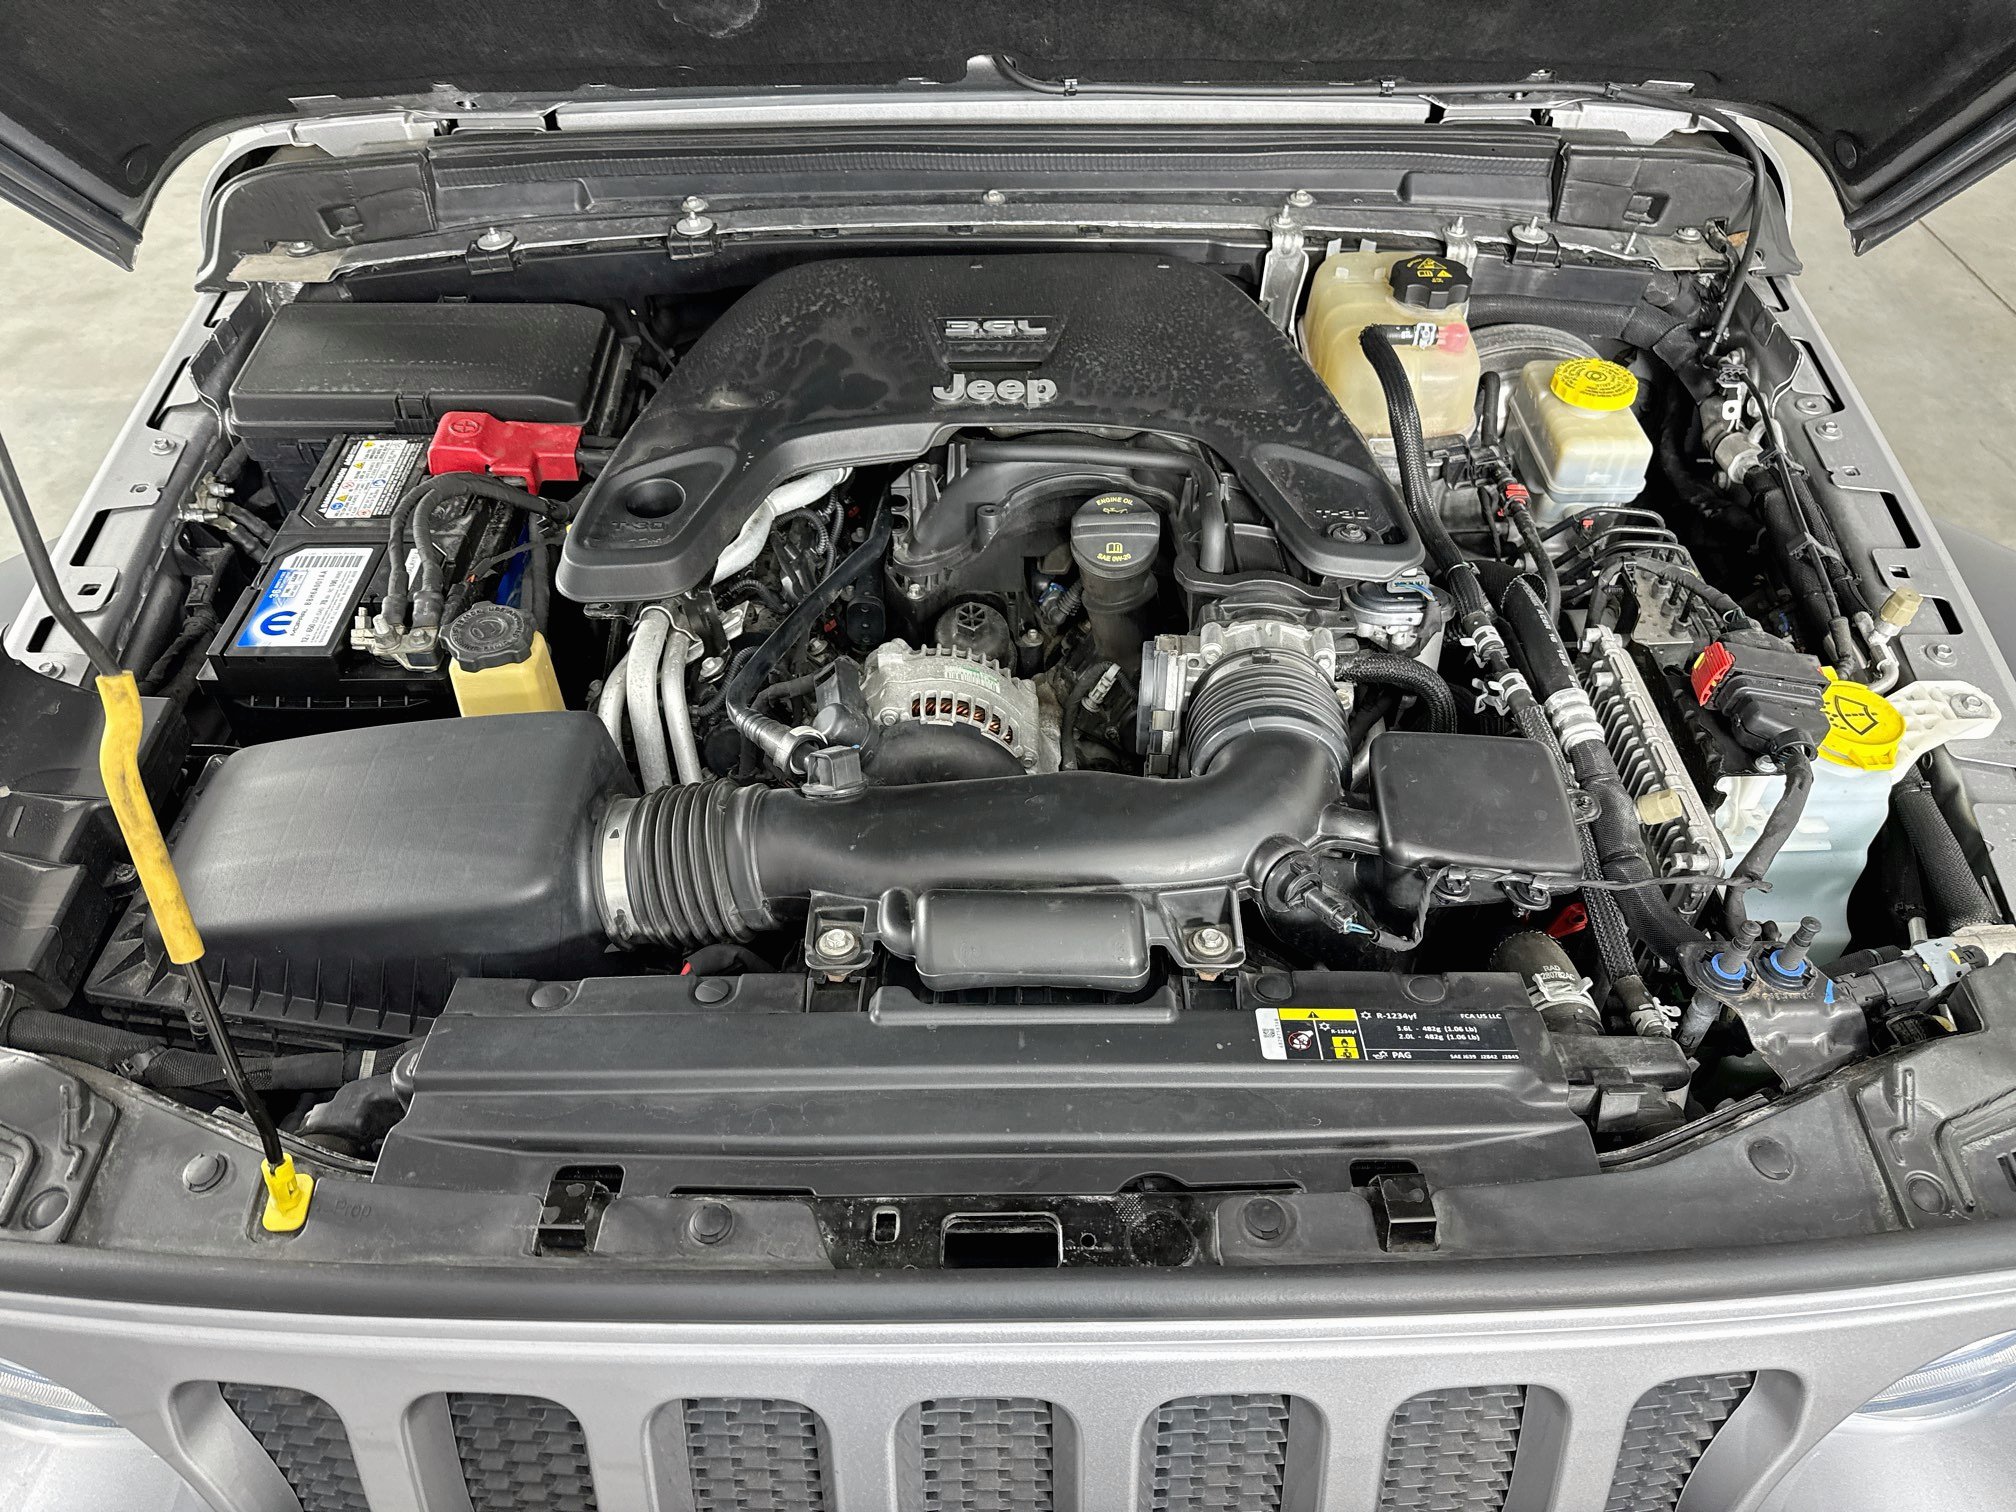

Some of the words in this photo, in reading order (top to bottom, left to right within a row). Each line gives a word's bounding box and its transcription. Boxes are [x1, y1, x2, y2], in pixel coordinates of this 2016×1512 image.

[944, 320, 1047, 336] 3.6L
[932, 373, 1058, 407] Jeep
[1095, 496, 1122, 506] ENGINE
[1122, 497, 1134, 506] OIL
[1096, 552, 1112, 562] SAE
[1111, 553, 1132, 562] 0W-20
[267, 588, 282, 599] 36
[1376, 1012, 1418, 1021] R-1234yf
[1422, 1025, 1442, 1033] 482g
[1444, 1025, 1464, 1033] (1.06
[1464, 1026, 1478, 1034] Lb)
[1424, 1033, 1444, 1041] 482g
[1446, 1033, 1467, 1041] (1.06
[1467, 1034, 1480, 1042] Lb)
[1392, 1051, 1412, 1059] PAG
